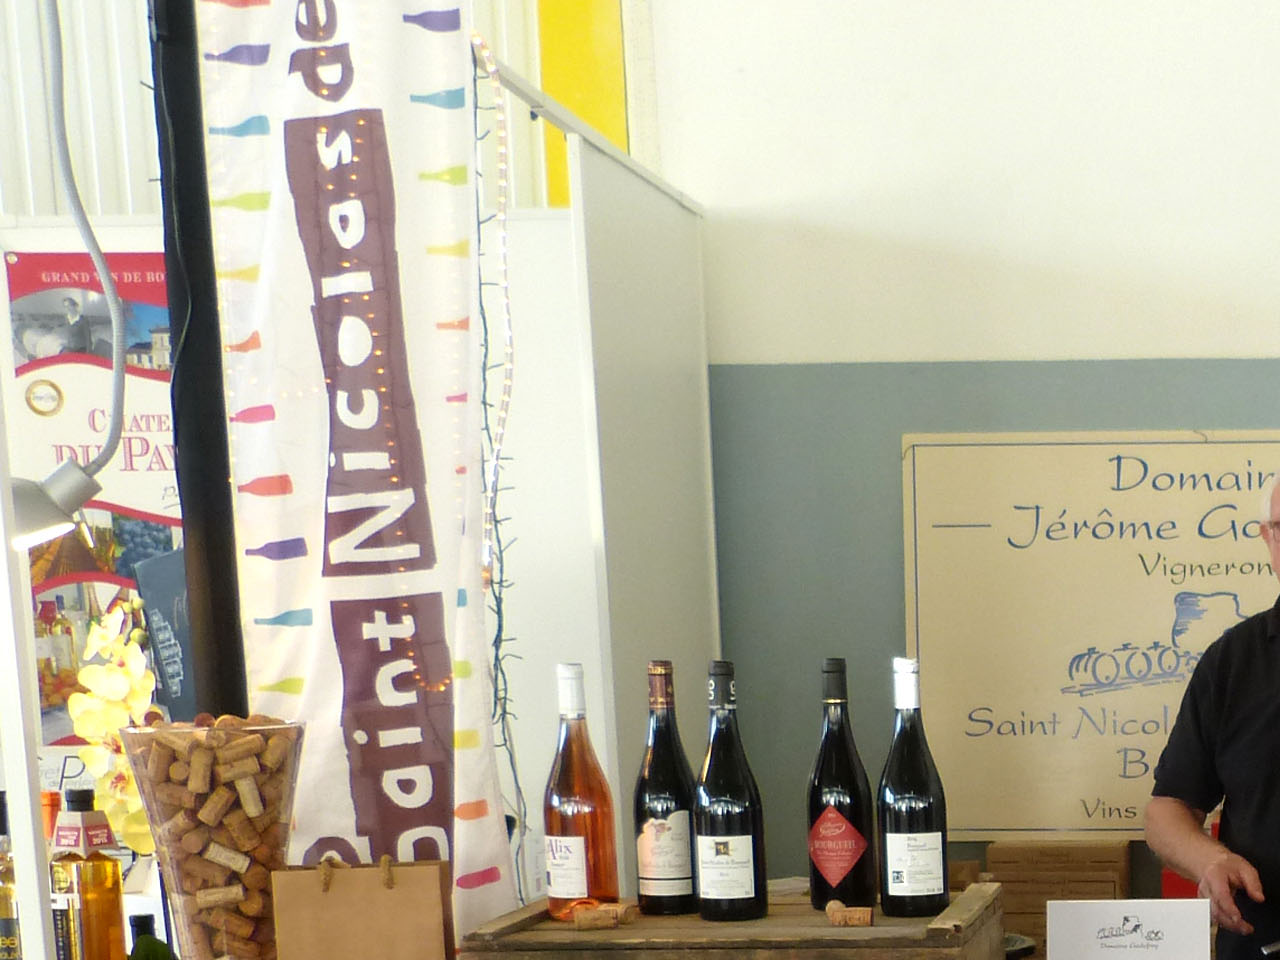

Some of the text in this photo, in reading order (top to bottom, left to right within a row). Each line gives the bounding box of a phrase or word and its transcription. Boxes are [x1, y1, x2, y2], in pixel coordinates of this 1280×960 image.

[41, 271, 90, 284] GRAND
[123, 271, 142, 283] DE
[316, 131, 421, 563] Nicolas
[1007, 504, 1178, 549] Jérôme
[965, 706, 1061, 739] Saint
[1080, 798, 1138, 820] Vins
